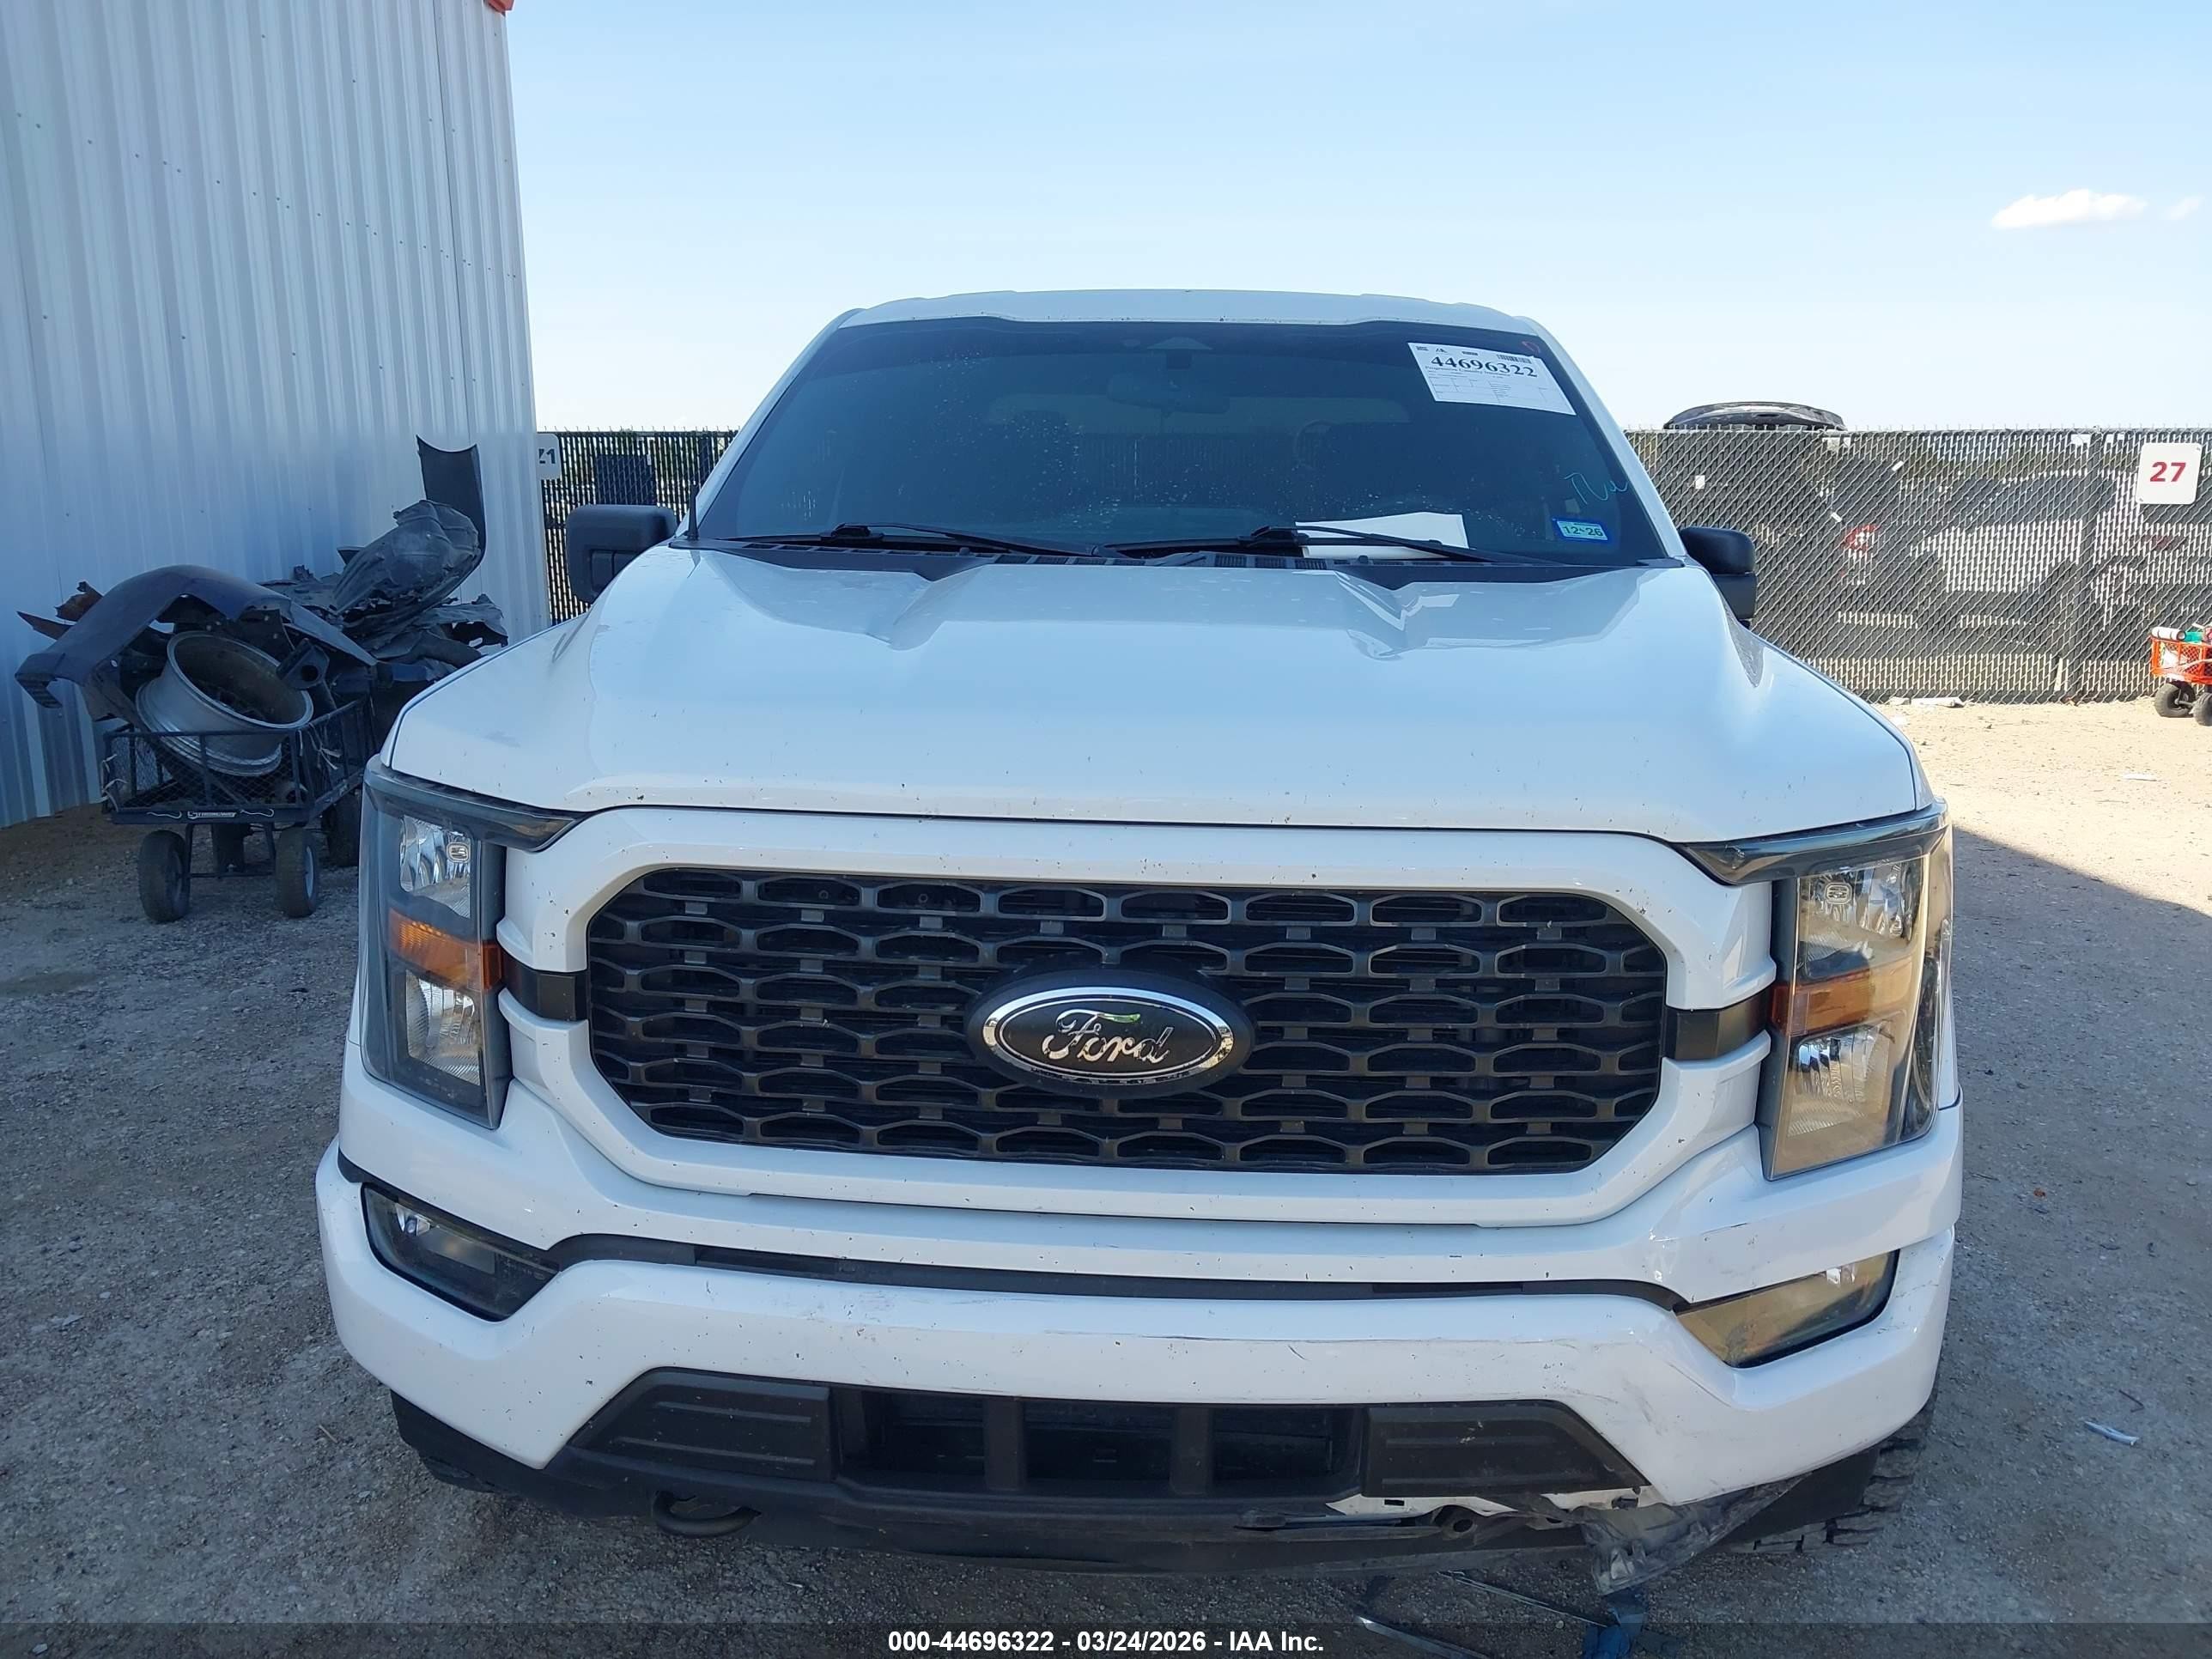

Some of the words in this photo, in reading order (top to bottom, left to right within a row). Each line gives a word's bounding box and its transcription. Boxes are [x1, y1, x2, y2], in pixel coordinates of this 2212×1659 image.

[1431, 356, 1538, 378] 44696322
[2149, 461, 2187, 483] 27
[1563, 526, 1603, 537] 12-26
[1042, 1008, 1175, 1064] Ford
